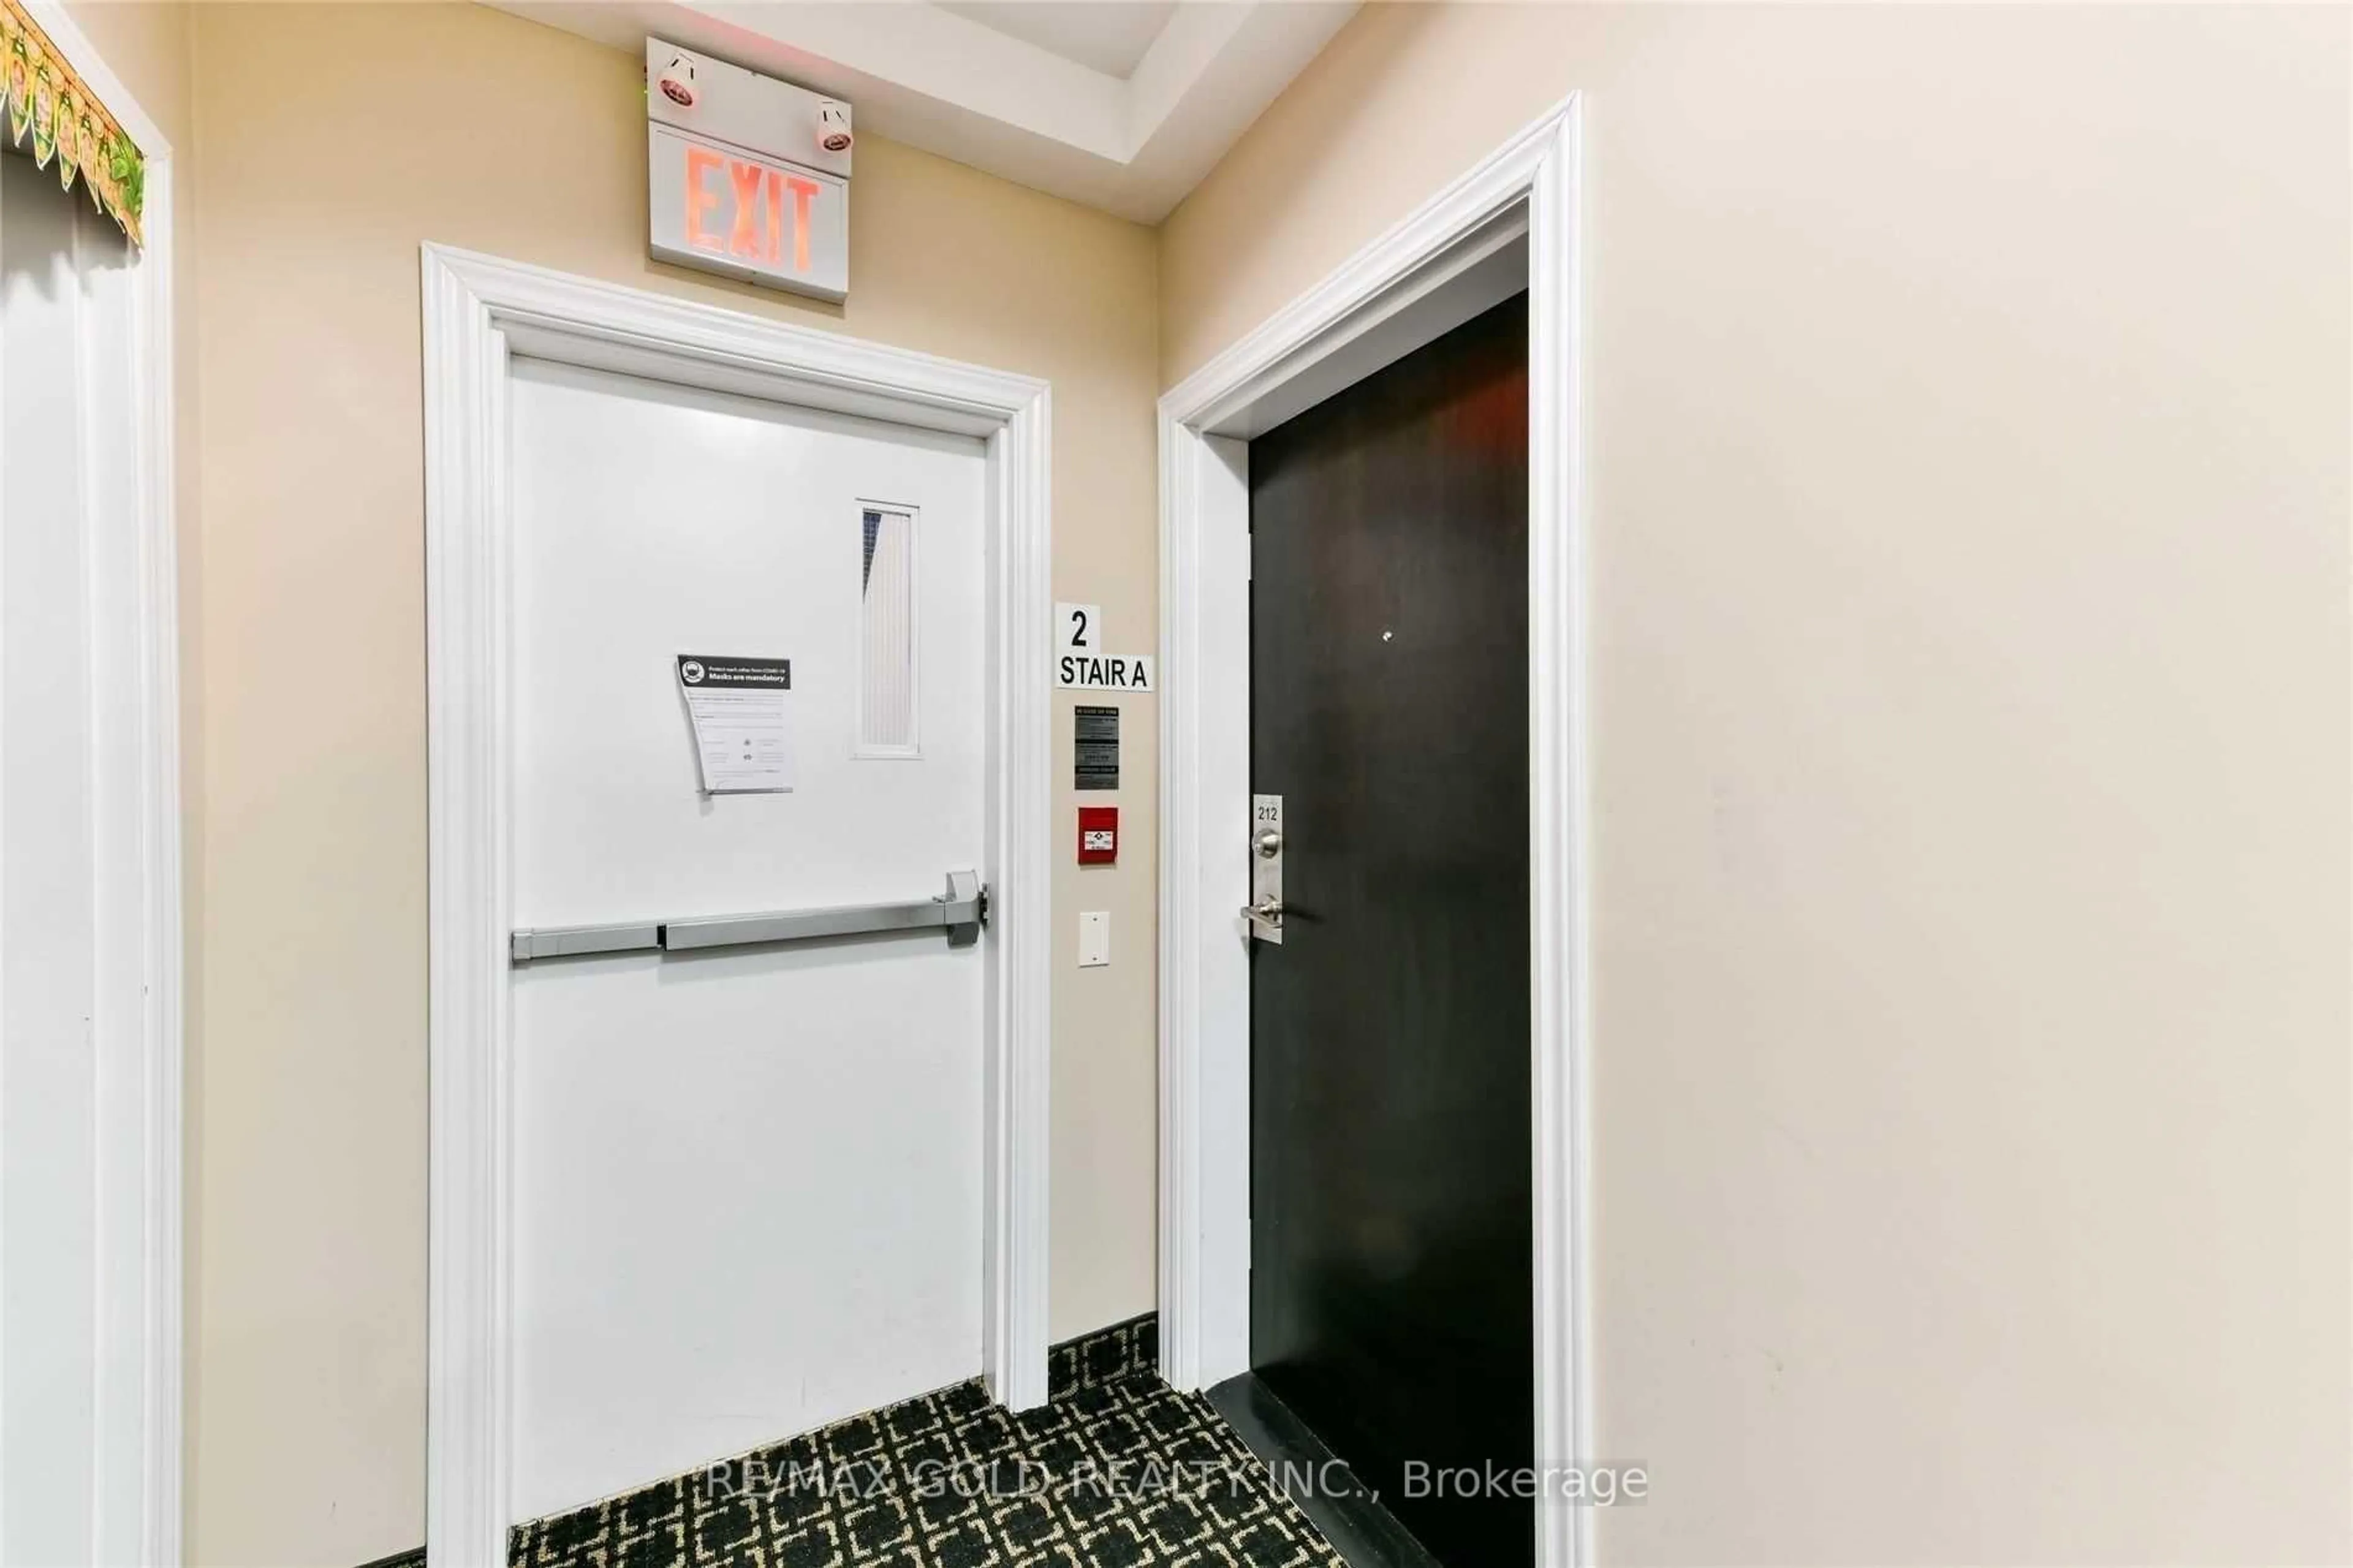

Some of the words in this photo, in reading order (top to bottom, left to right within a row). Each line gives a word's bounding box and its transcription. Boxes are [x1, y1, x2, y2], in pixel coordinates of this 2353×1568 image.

[687, 150, 819, 271] EXIT
[1072, 610, 1087, 646] 2
[746, 674, 785, 683] mandatory
[1061, 656, 1126, 686] STAIR
[1132, 661, 1147, 687] A
[1258, 806, 1277, 821] 212
